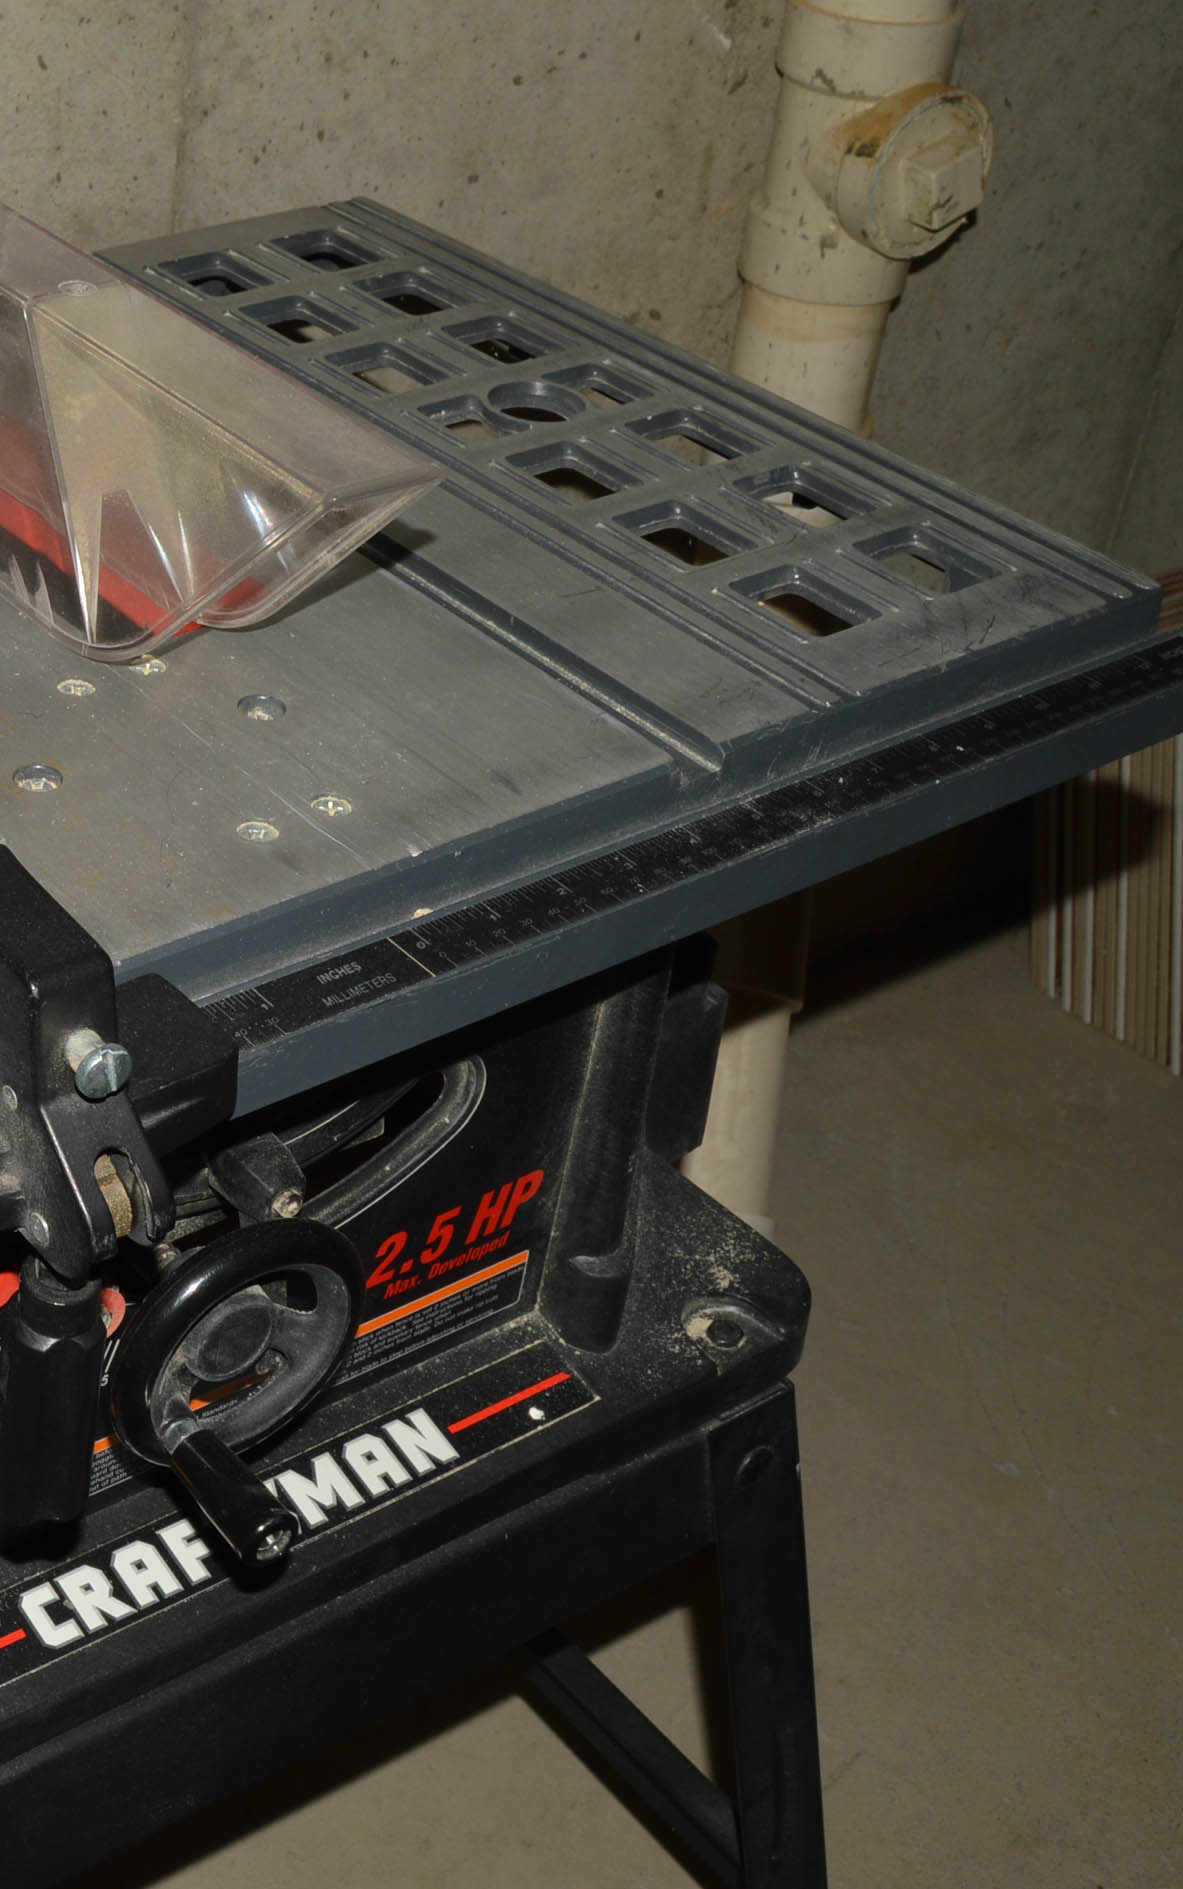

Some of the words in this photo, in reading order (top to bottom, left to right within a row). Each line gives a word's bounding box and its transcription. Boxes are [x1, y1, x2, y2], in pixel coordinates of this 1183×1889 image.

[316, 960, 363, 986] INCHES
[321, 971, 398, 1008] MILLIMETERS
[464, 1168, 545, 1246] HP
[383, 1274, 423, 1300] Max.
[427, 1229, 512, 1281] Developed
[20, 1407, 461, 1650] CRAFMAN
